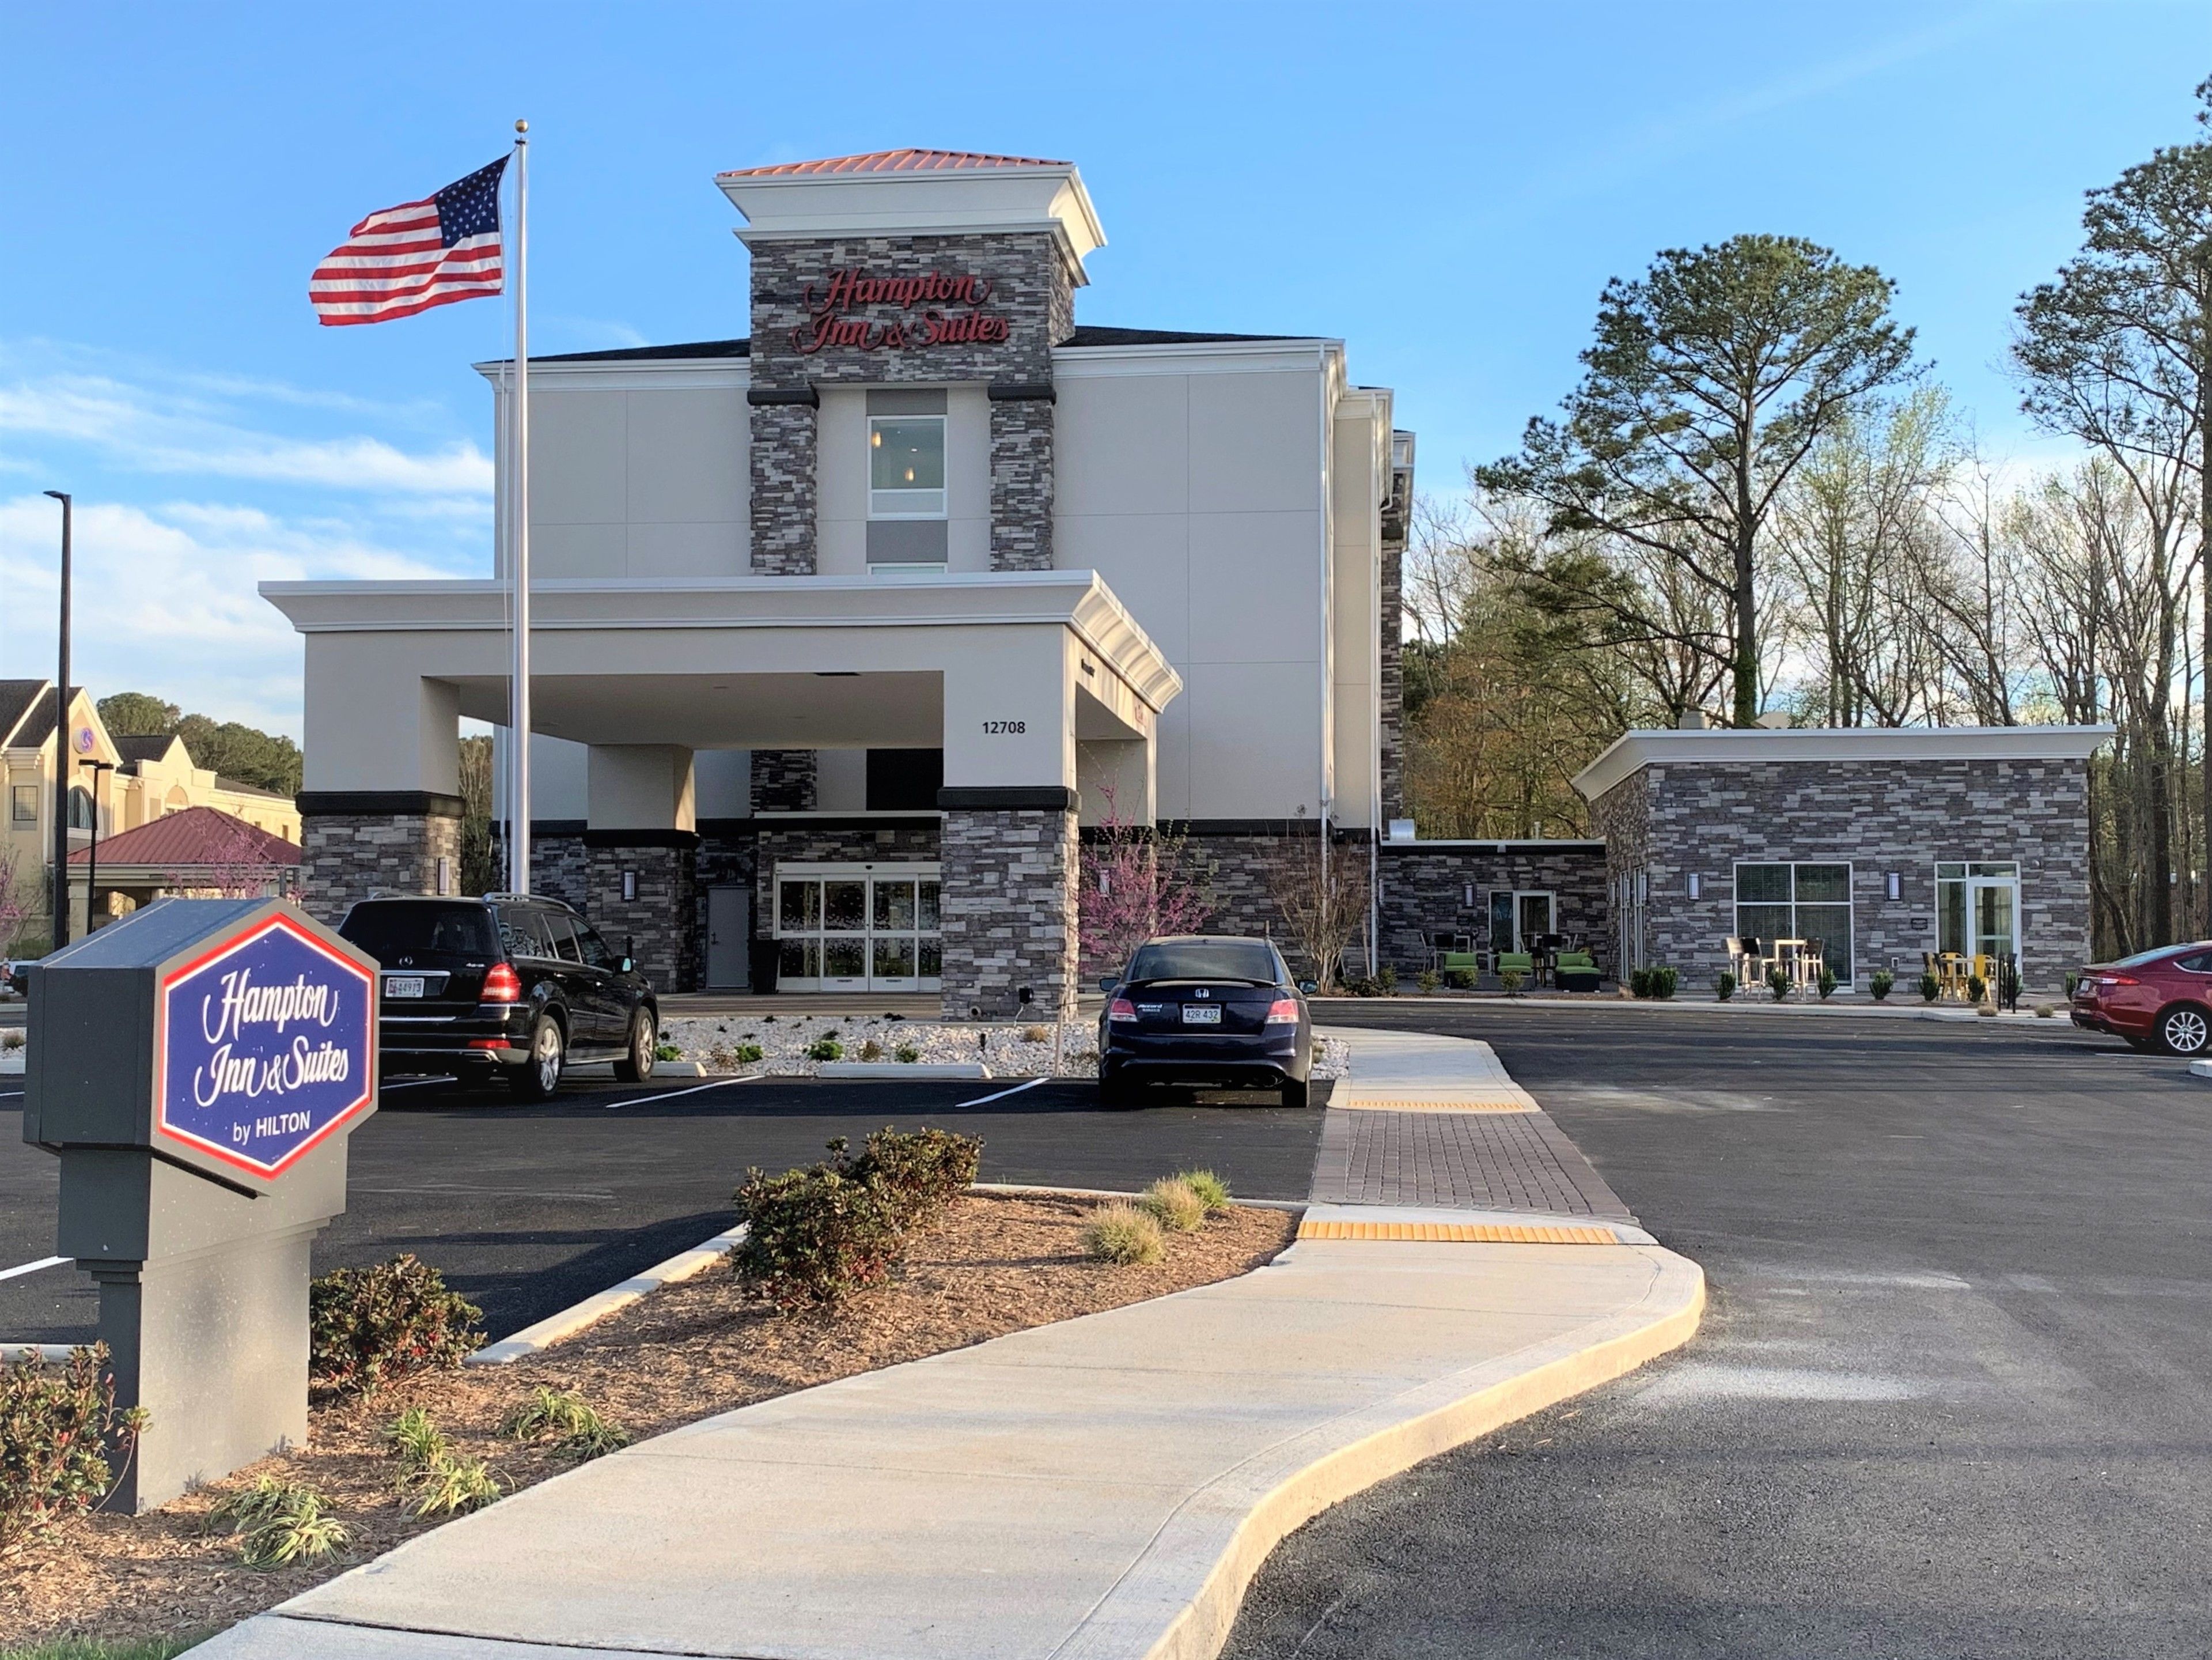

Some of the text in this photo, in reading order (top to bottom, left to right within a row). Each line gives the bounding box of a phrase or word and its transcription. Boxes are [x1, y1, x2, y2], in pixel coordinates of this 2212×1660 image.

[804, 267, 992, 314] Hampton
[793, 309, 1009, 353] Inn & Suites
[982, 721, 1025, 733] 12708
[203, 967, 338, 1043] Hampton
[195, 1035, 349, 1107] Inn & Suites
[233, 1110, 311, 1145] by HILTON
